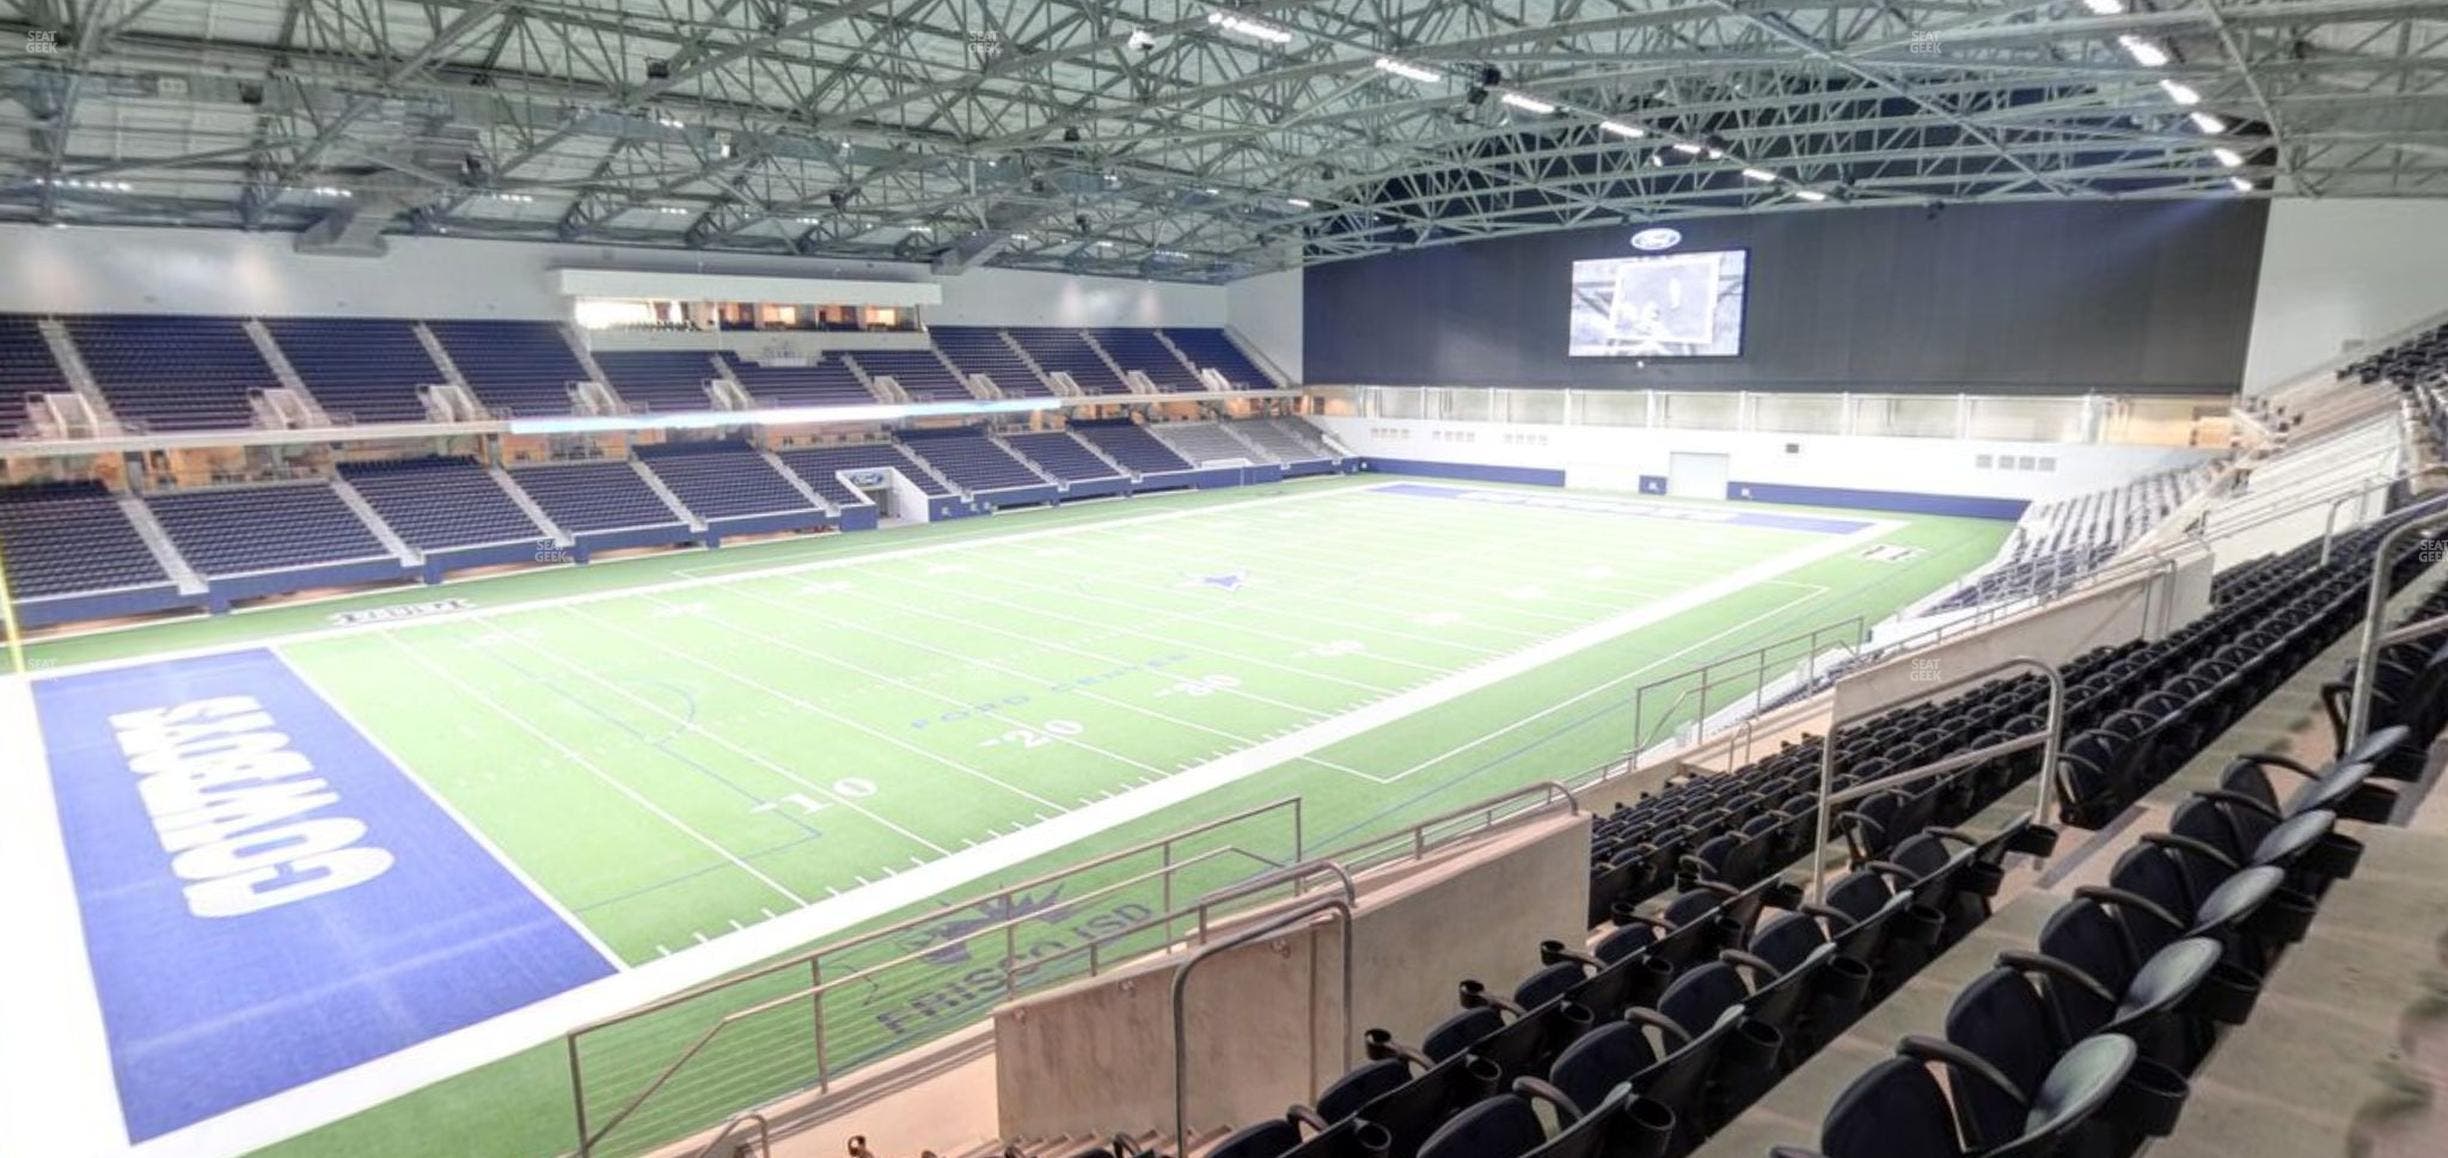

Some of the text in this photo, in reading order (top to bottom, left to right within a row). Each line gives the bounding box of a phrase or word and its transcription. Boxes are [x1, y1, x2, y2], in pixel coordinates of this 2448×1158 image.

[1001, 719, 1085, 749] 20
[107, 695, 395, 918] COWBOYS
[780, 776, 879, 816] 10
